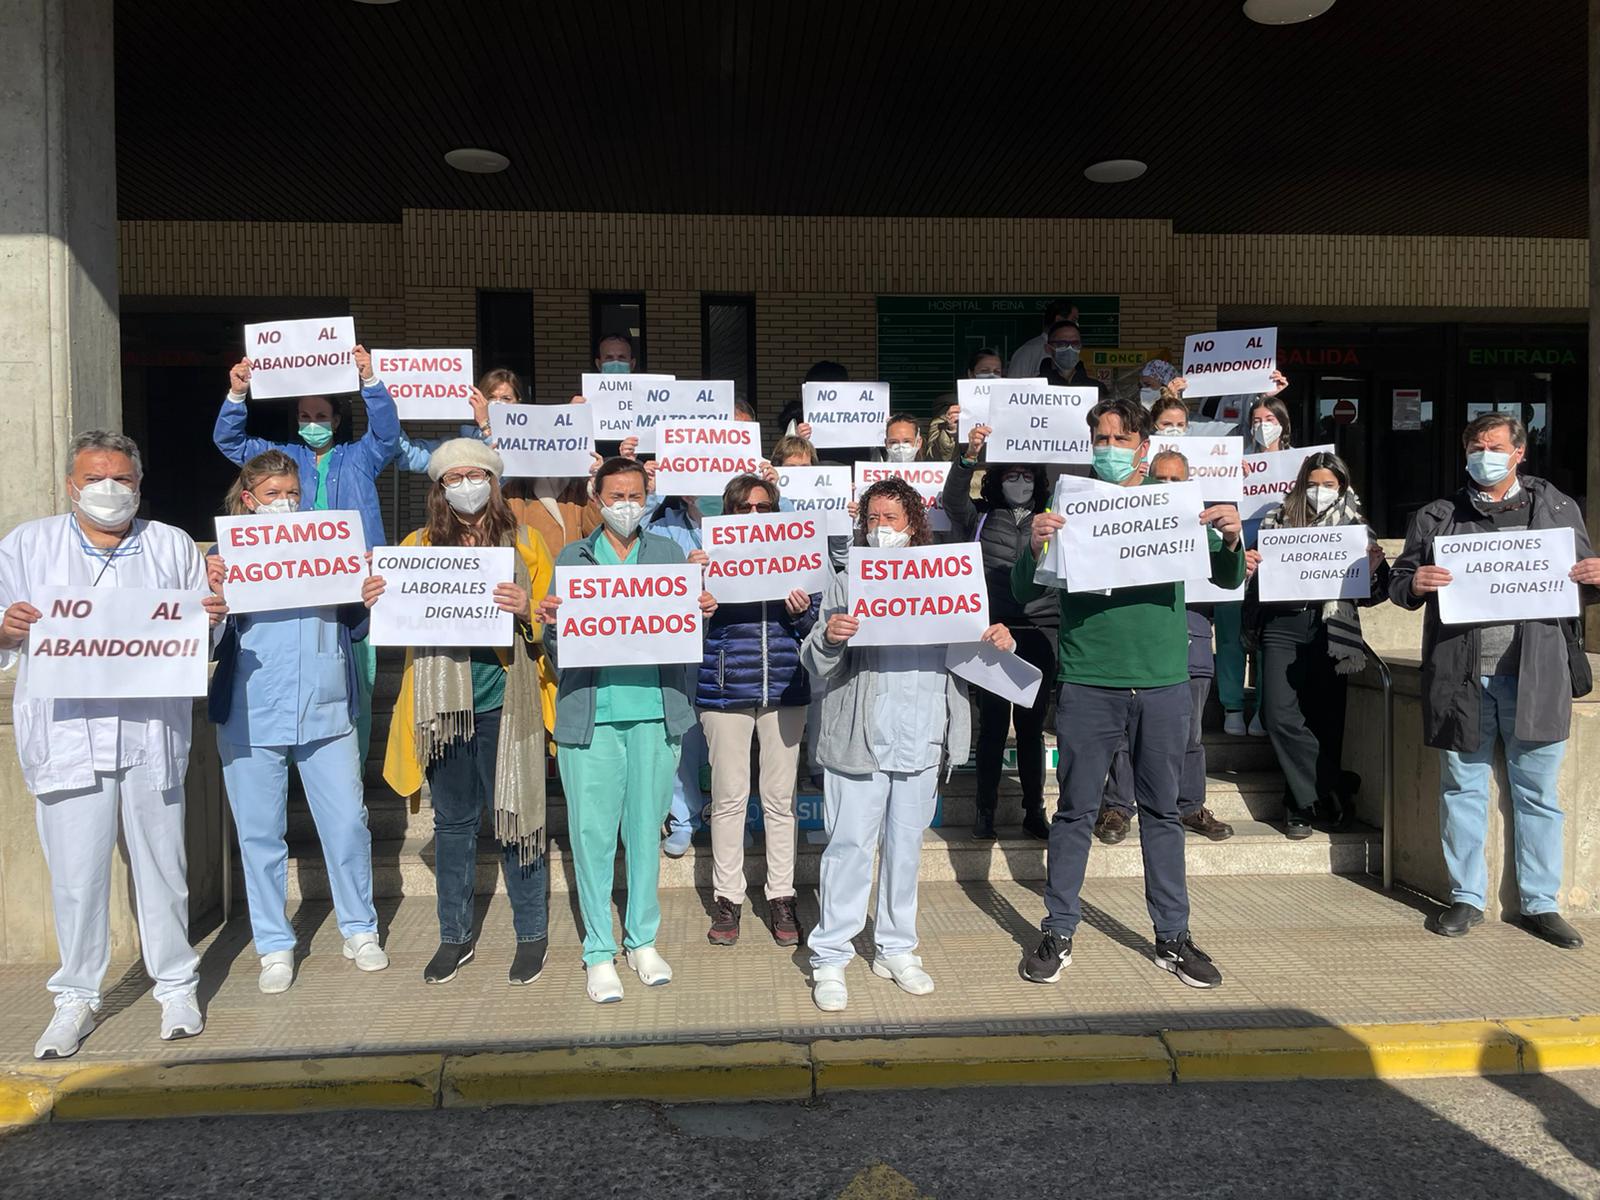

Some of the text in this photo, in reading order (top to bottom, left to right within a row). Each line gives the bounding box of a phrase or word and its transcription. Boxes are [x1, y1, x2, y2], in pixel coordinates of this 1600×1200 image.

[928, 300, 982, 310] HOSPITAL
[992, 300, 1024, 310] REINA
[258, 327, 337, 344] NO AL
[1194, 337, 1262, 352] NO AL
[251, 351, 351, 372] ABANDONO!!
[1109, 354, 1142, 363] ONCE
[1278, 348, 1360, 366] SALIDA
[1469, 347, 1577, 365] ENTRADA
[380, 358, 462, 372] ESTAMOS
[1186, 357, 1272, 375] ABANDONO!!
[388, 383, 468, 398] GOTADAS
[647, 390, 714, 402] NO AL
[817, 390, 874, 401] NO AL
[974, 385, 990, 395] AU
[1009, 393, 1081, 406] AUMENTO
[506, 413, 573, 426] NO AL
[808, 410, 885, 423] MALTRATO!!
[1031, 417, 1048, 428] DE
[497, 437, 588, 451] MALTRATO!!
[665, 429, 751, 445] ESTAMOS
[1006, 438, 1089, 453] PLANTILLA!!
[1210, 444, 1228, 456] AL
[659, 456, 756, 473] AGOTADAS
[1189, 466, 1238, 478] DONO!!
[779, 475, 832, 487] O AL
[1243, 480, 1297, 497] ABANDO
[791, 498, 846, 511] TRATO!!
[1066, 492, 1169, 516] CONDICIONES
[231, 521, 350, 547] ESTAMOS
[712, 520, 815, 545] ESTAMOS
[1093, 516, 1178, 537] LABORALES
[1262, 532, 1342, 546] CONDICIONES
[1441, 538, 1541, 554] CONDICIONES
[1120, 539, 1195, 559] DIGNAS!!!
[1281, 550, 1347, 563] LABORALES
[228, 555, 361, 584] AGOTADAS
[378, 557, 480, 570] CONDICIONES
[708, 552, 821, 578] AGOTADAS
[861, 555, 972, 580] ESTAMOS
[1466, 560, 1549, 573] LABORALES
[1300, 568, 1360, 580] DIGNAS!!!
[401, 582, 486, 594] LABORALES
[570, 576, 687, 599] ESTAMOS
[1490, 580, 1564, 594] DIGNAS!!!
[51, 600, 182, 620] NO AL
[425, 605, 500, 618] DIGNAS!!!
[853, 593, 981, 617] AGOTADAS
[563, 614, 696, 637] AGOTADOS
[34, 638, 199, 657] ABANDONO!!
